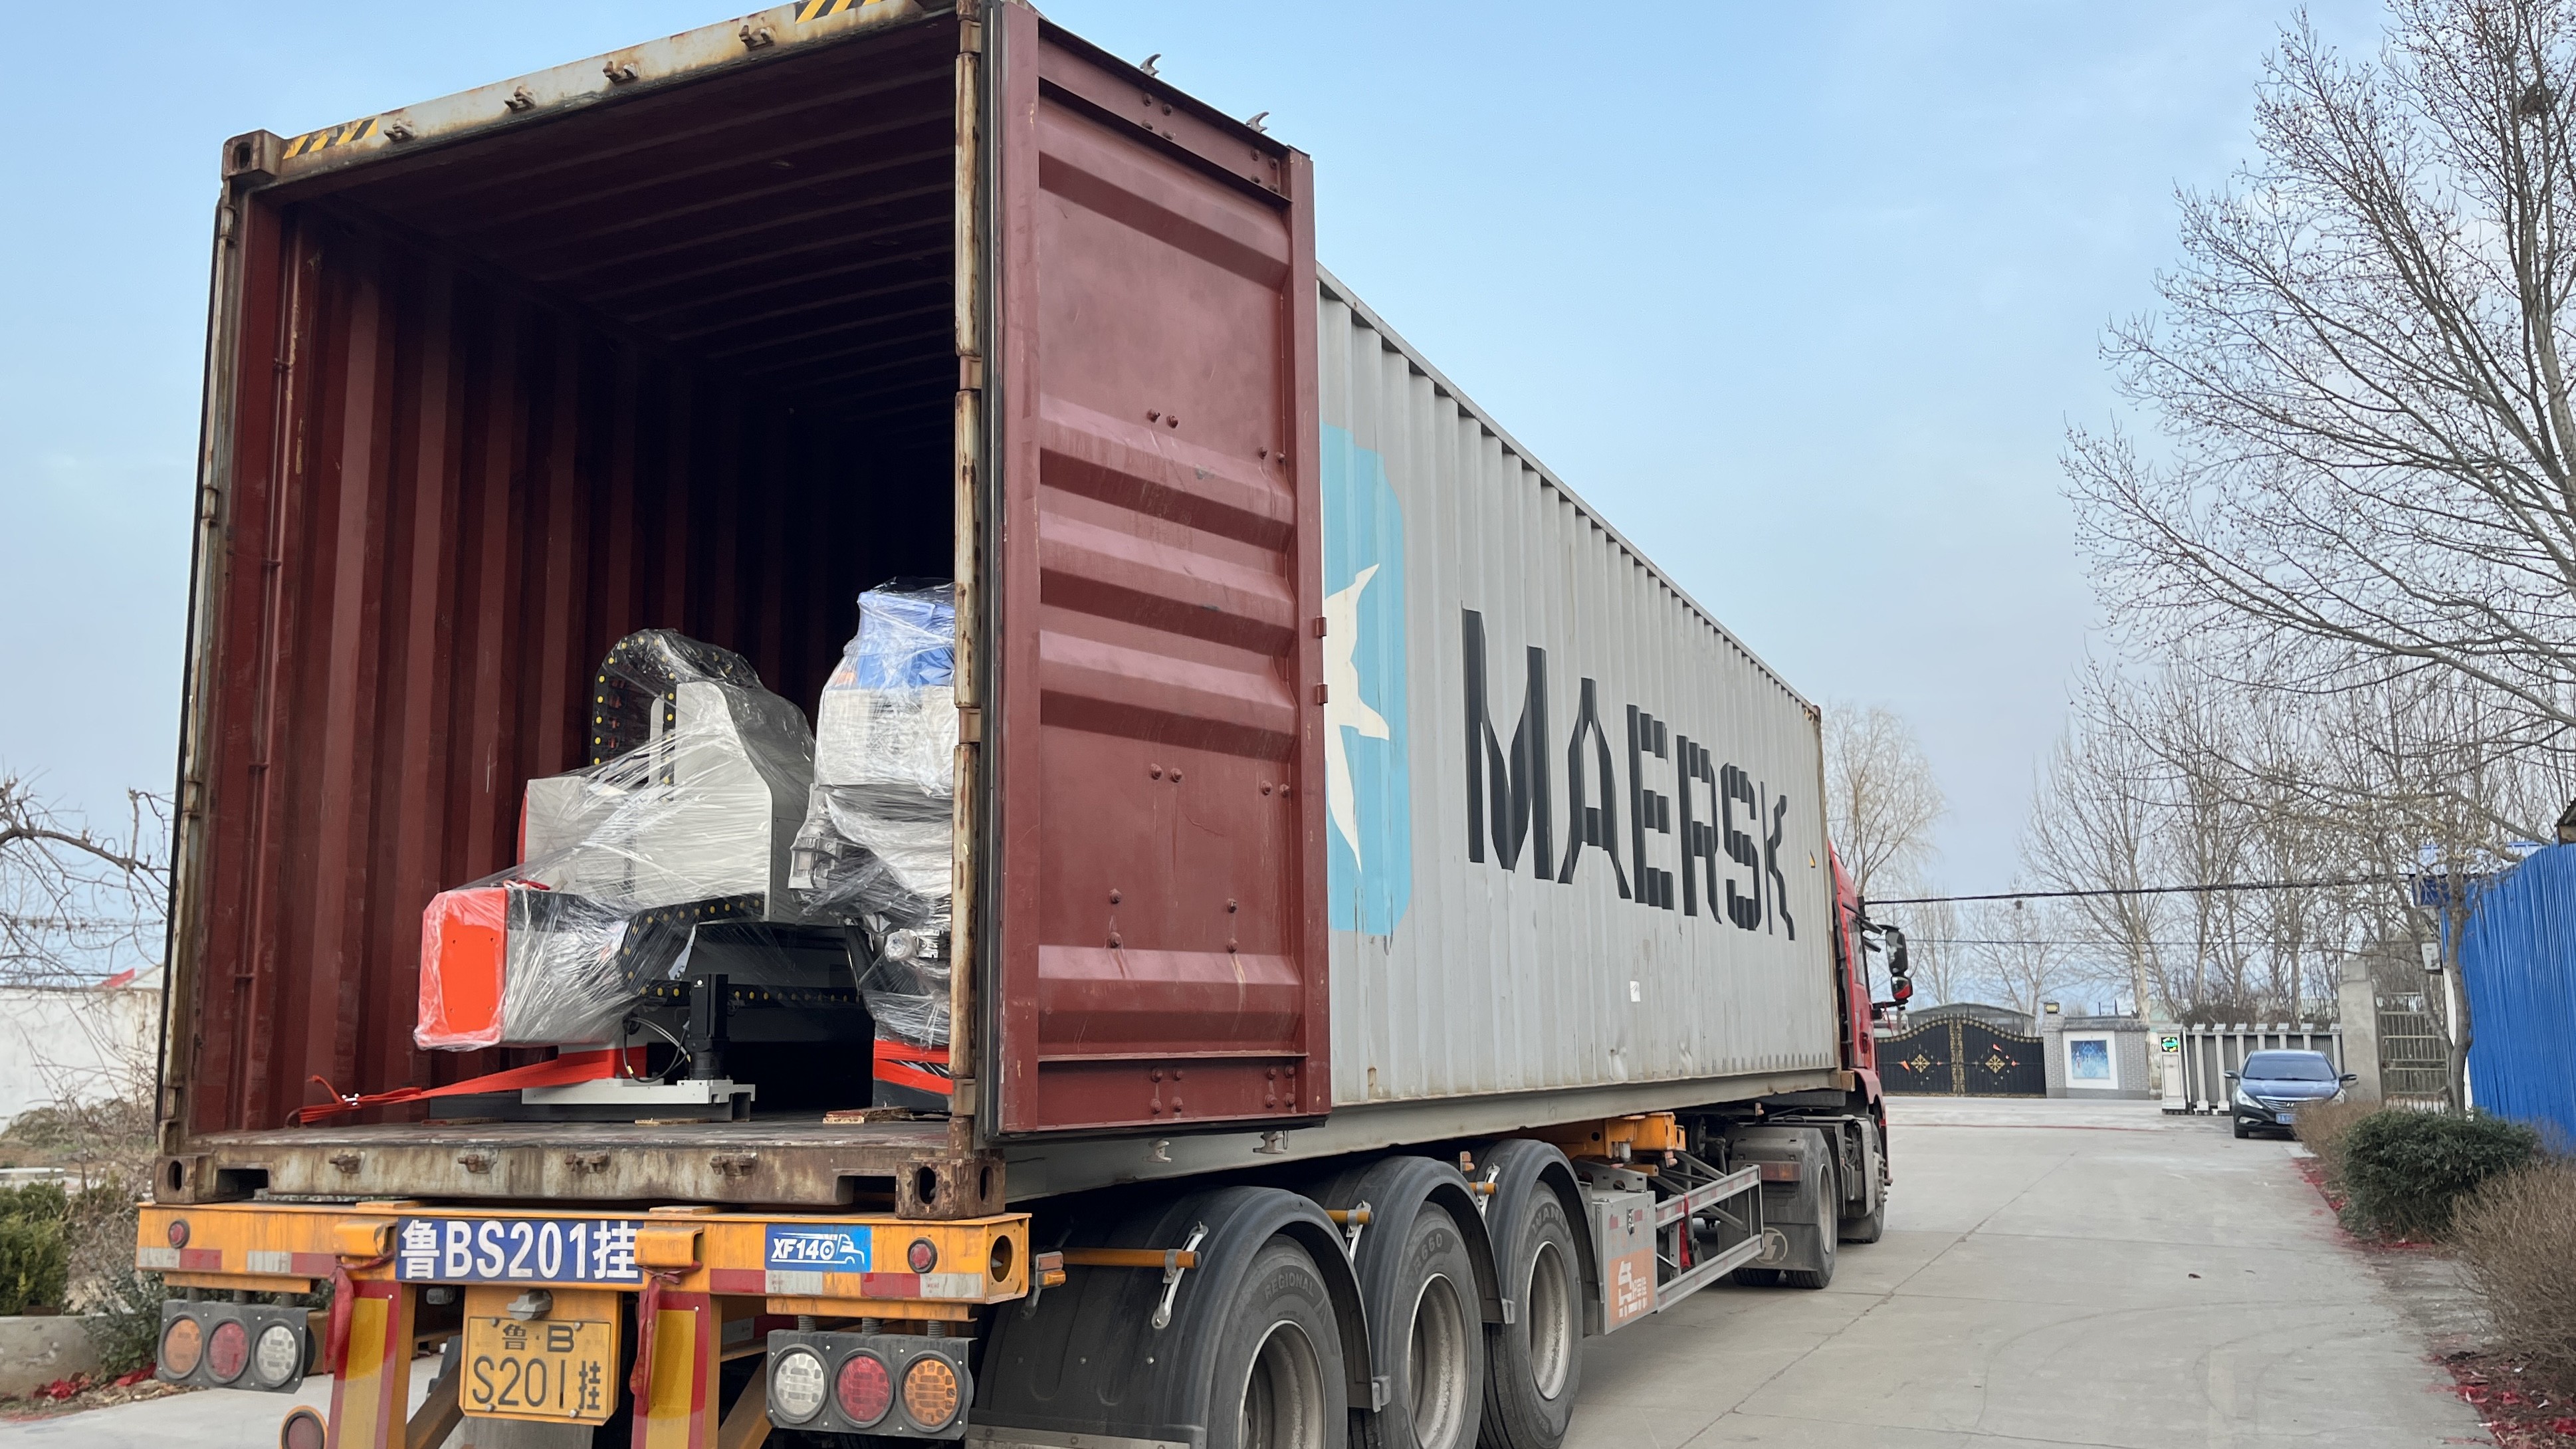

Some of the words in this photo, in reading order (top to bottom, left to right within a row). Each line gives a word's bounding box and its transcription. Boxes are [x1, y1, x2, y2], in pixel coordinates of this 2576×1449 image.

[1462, 608, 1794, 941] MAERSK
[401, 1219, 638, 1279] 鲁BS201挂
[771, 1238, 835, 1260] XF140
[1264, 1272, 1314, 1300] REGIONAL
[473, 1356, 600, 1410] S201挂
